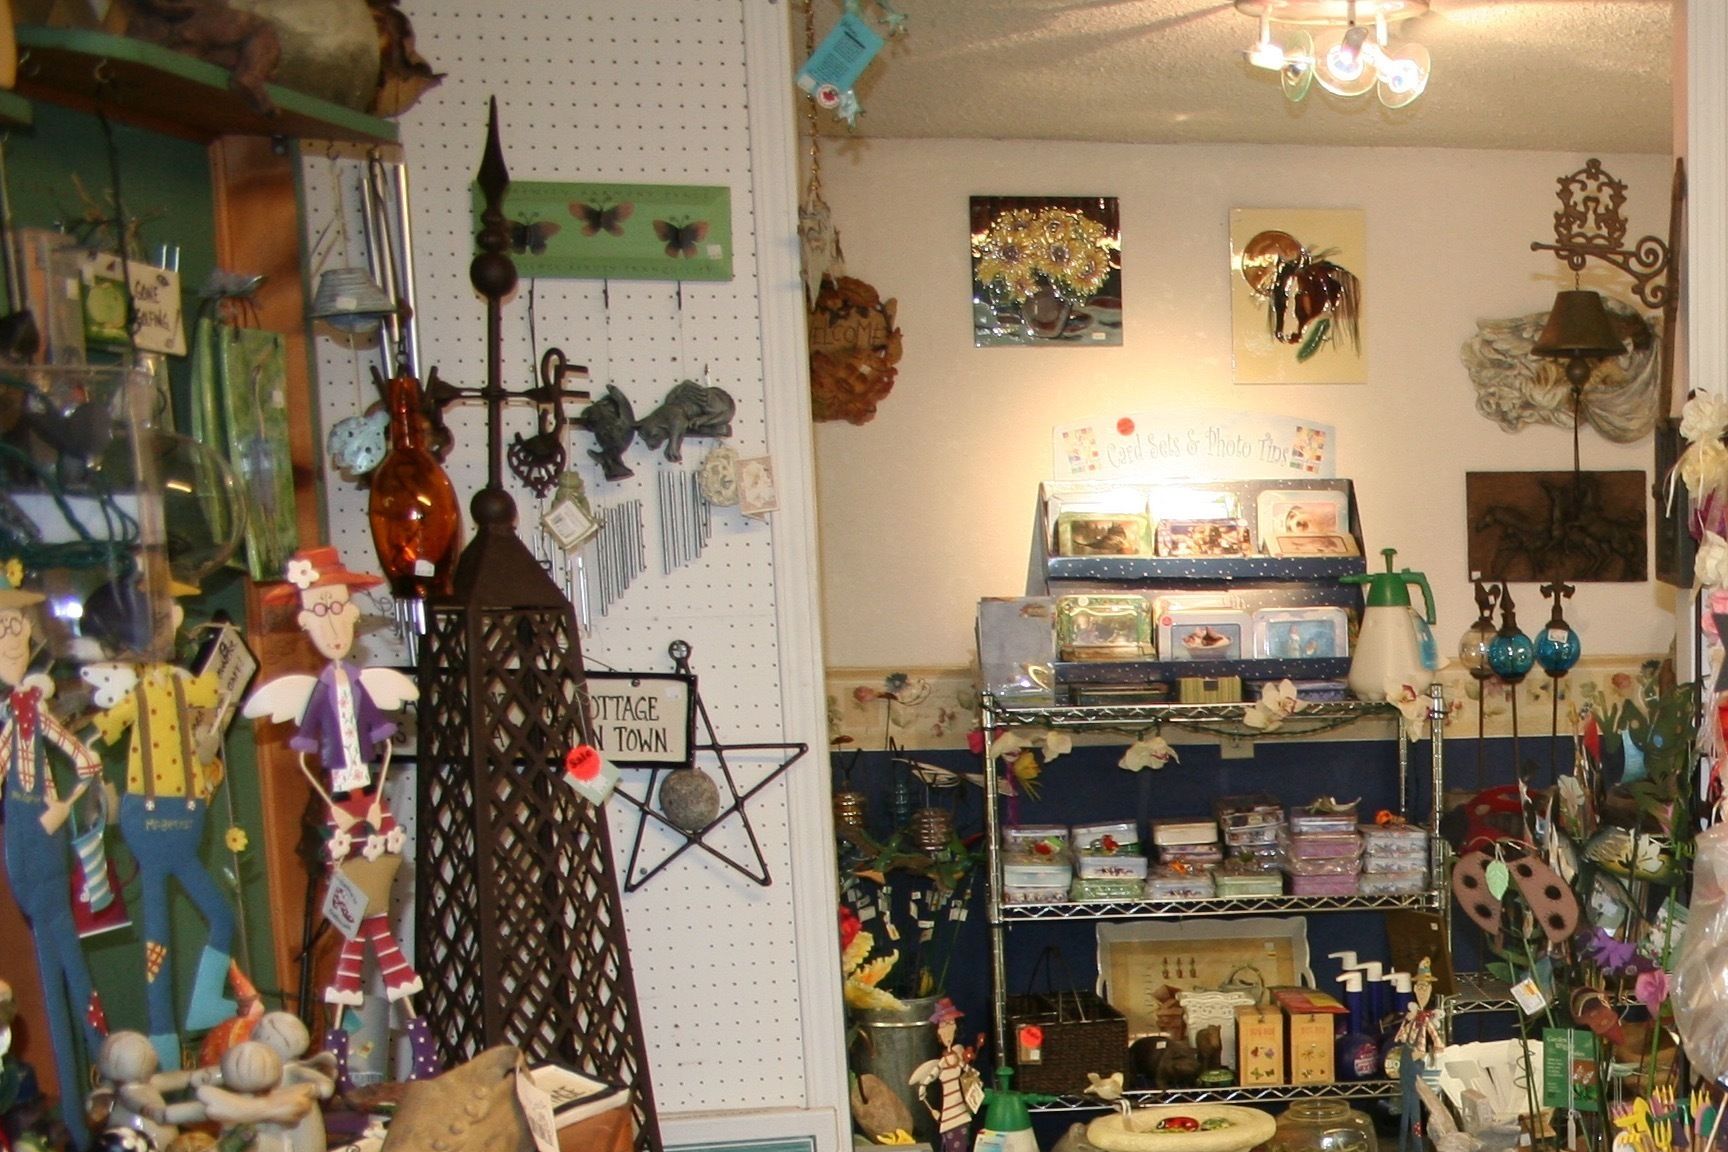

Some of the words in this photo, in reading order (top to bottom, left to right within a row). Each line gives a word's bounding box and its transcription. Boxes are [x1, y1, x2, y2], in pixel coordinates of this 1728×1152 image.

[811, 319, 884, 347] ELCOME
[1107, 433, 1142, 468] Card
[1148, 432, 1180, 459] Sets
[1207, 426, 1252, 458] Photo
[590, 695, 659, 721] OTTAGE
